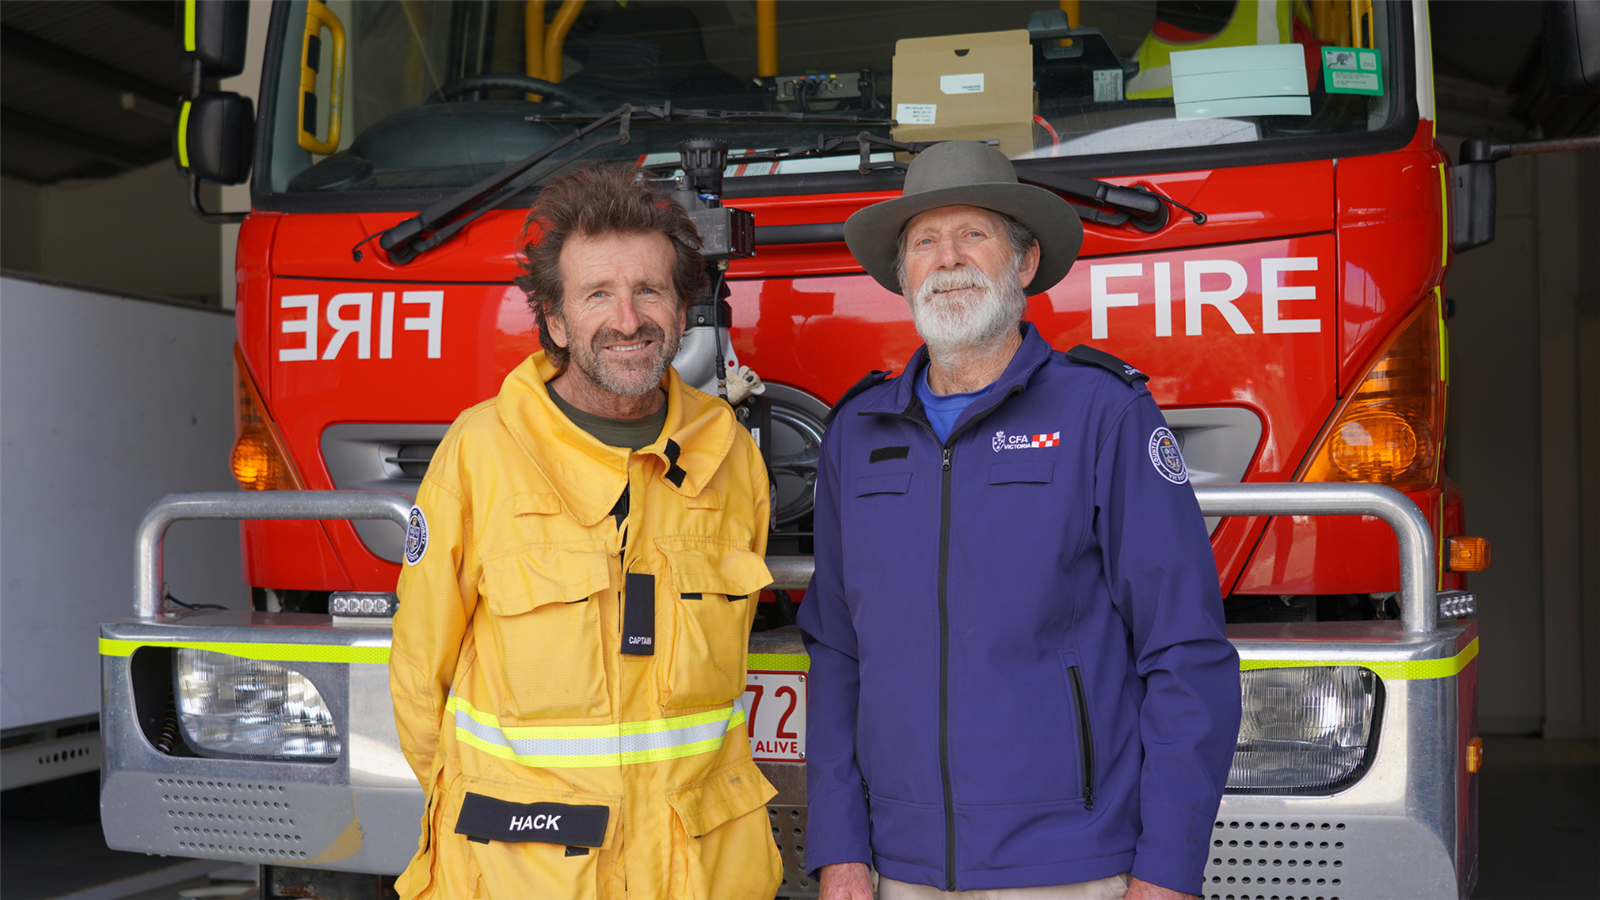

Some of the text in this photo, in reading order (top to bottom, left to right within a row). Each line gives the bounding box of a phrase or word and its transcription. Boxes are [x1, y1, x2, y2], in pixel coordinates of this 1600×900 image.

[1090, 257, 1321, 339] FIRE
[1008, 434, 1028, 444] CFA
[628, 636, 652, 645] CAPTAIN
[745, 684, 798, 739] 72
[755, 740, 798, 754] ALIVE
[509, 814, 562, 831] HACK
